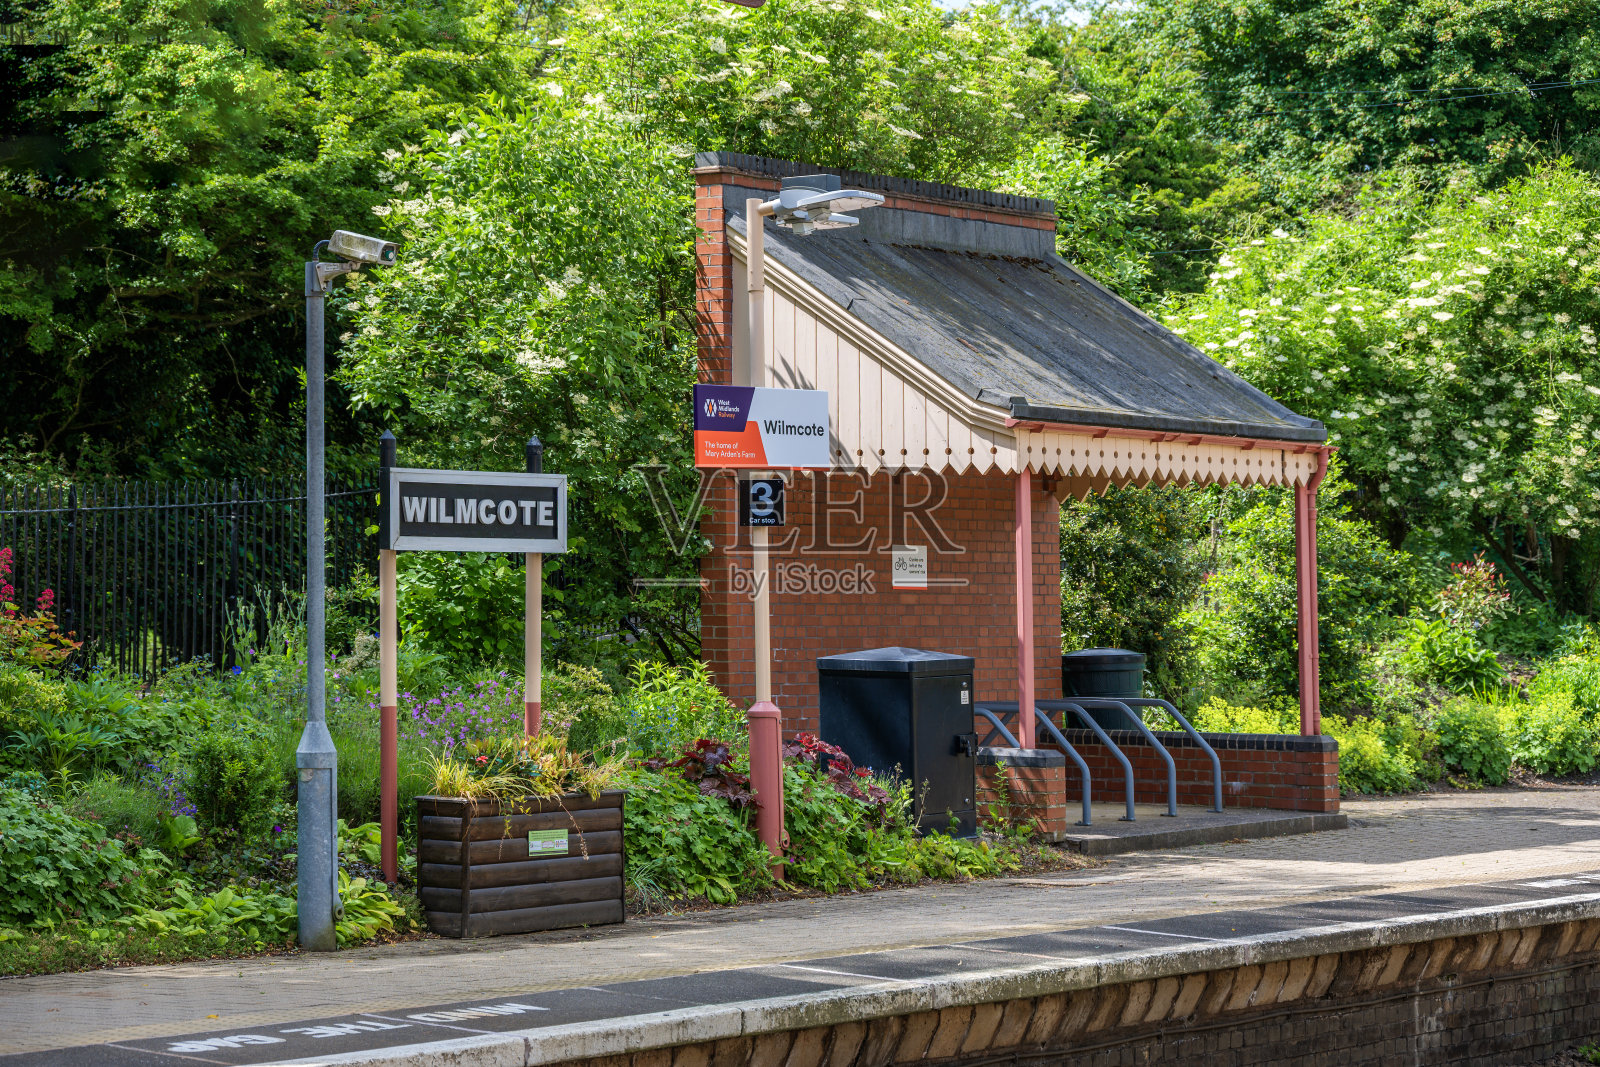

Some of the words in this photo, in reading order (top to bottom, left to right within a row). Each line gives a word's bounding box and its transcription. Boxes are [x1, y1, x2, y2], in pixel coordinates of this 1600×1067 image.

[764, 419, 825, 436] Wilmcote
[705, 441, 716, 449] The
[716, 441, 732, 449] home
[732, 442, 739, 450] of
[705, 450, 720, 459] Mary
[720, 450, 741, 458] Arden's
[750, 482, 774, 517] 3
[402, 496, 554, 527] WILMCOTE
[761, 517, 776, 525] stop
[407, 1003, 550, 1022] MIND
[280, 1020, 413, 1038] THE
[166, 1034, 286, 1052] GAP
